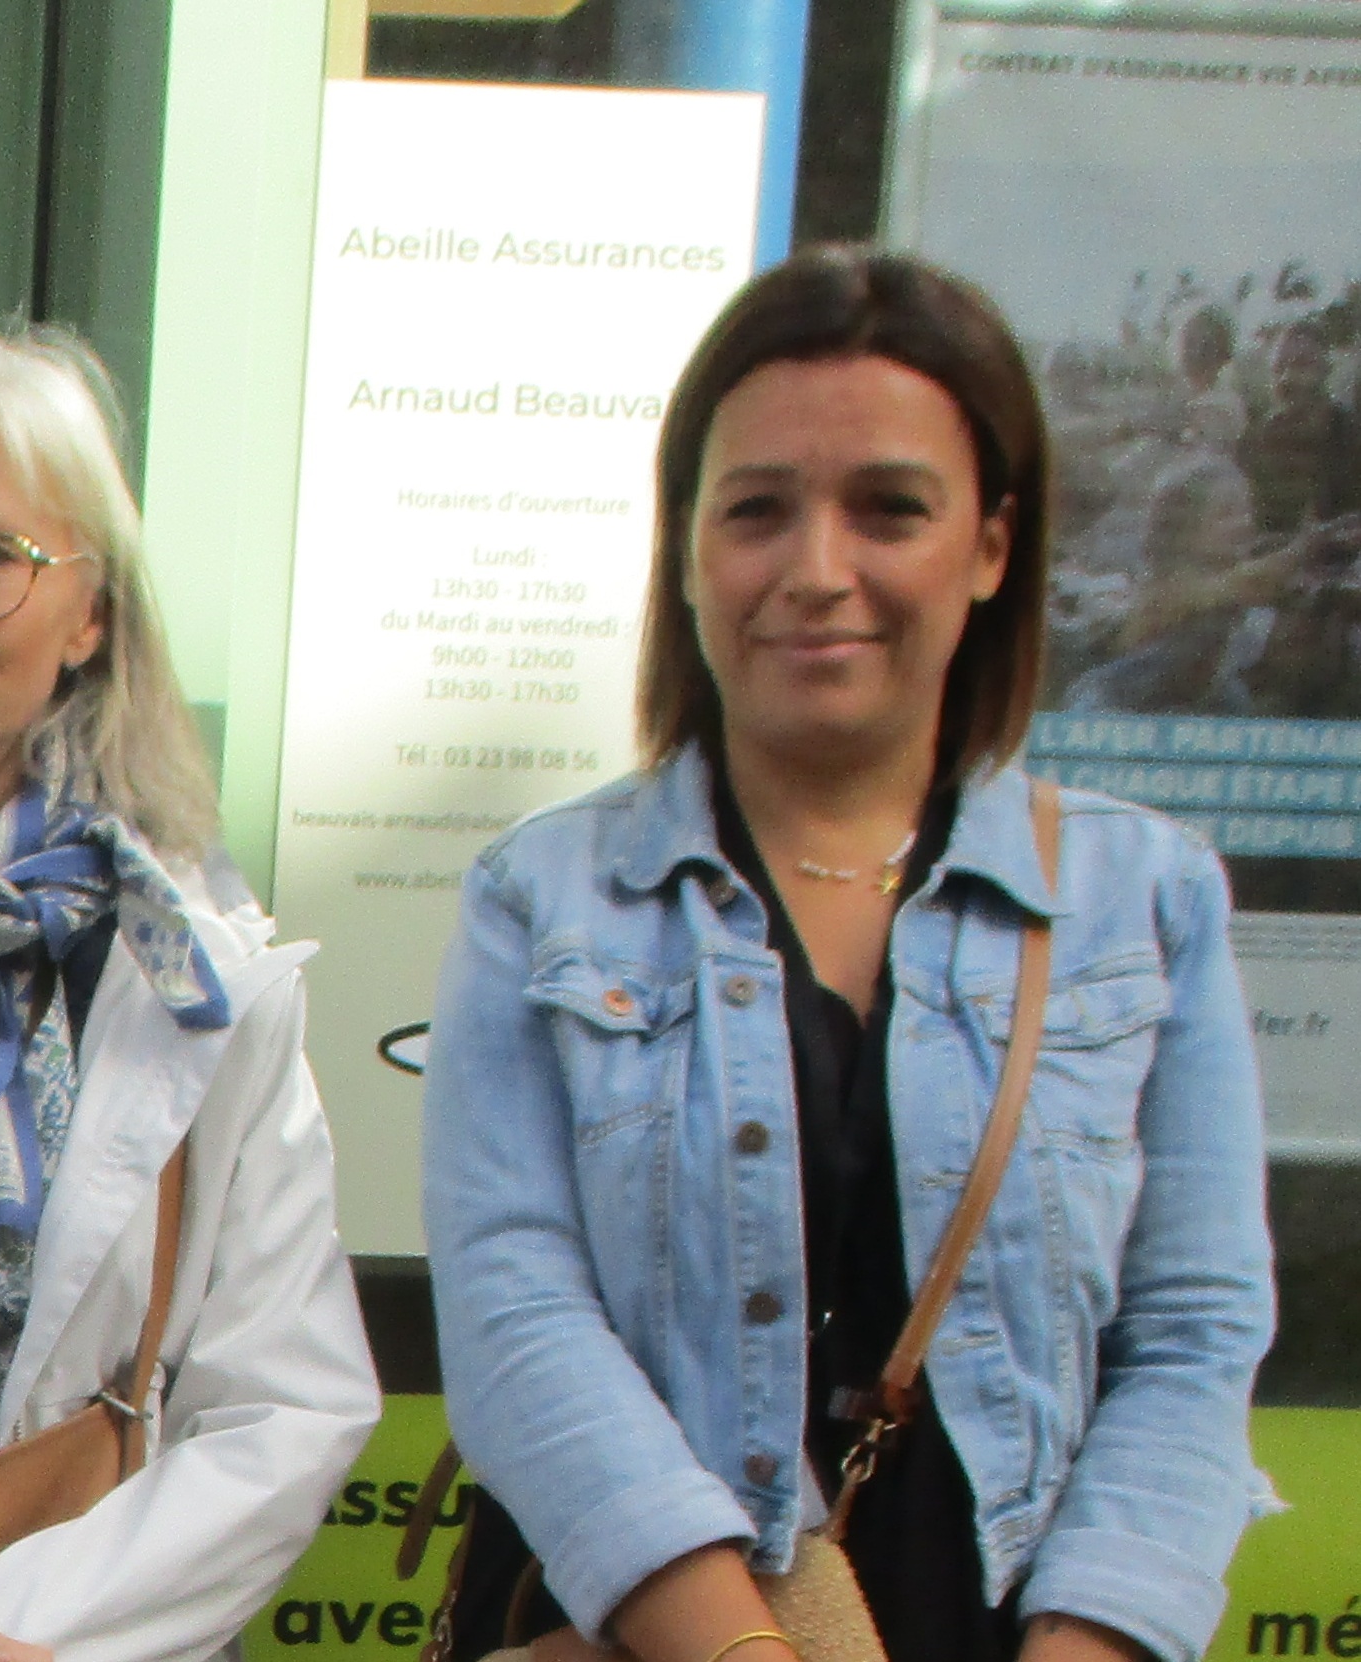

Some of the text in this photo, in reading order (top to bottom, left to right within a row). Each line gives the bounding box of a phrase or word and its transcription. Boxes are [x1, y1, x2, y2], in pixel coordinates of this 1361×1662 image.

[339, 227, 727, 273] Abeille Assurances
[348, 379, 667, 421] Arnaud Beauva
[397, 487, 632, 516] Horaires d'ouverture
[472, 545, 537, 568] Lundi
[431, 578, 499, 600] 13h30
[517, 581, 588, 604] 17h30
[380, 609, 410, 631] du
[416, 611, 480, 633] Mardi
[484, 616, 514, 635] au
[519, 616, 619, 639] vendredi
[431, 645, 488, 667] 9h00
[507, 648, 575, 670] 12h00
[424, 678, 493, 701] 13h30
[512, 680, 581, 704] 17h30
[444, 745, 471, 768] 03
[324, 1480, 476, 1527] ssu
